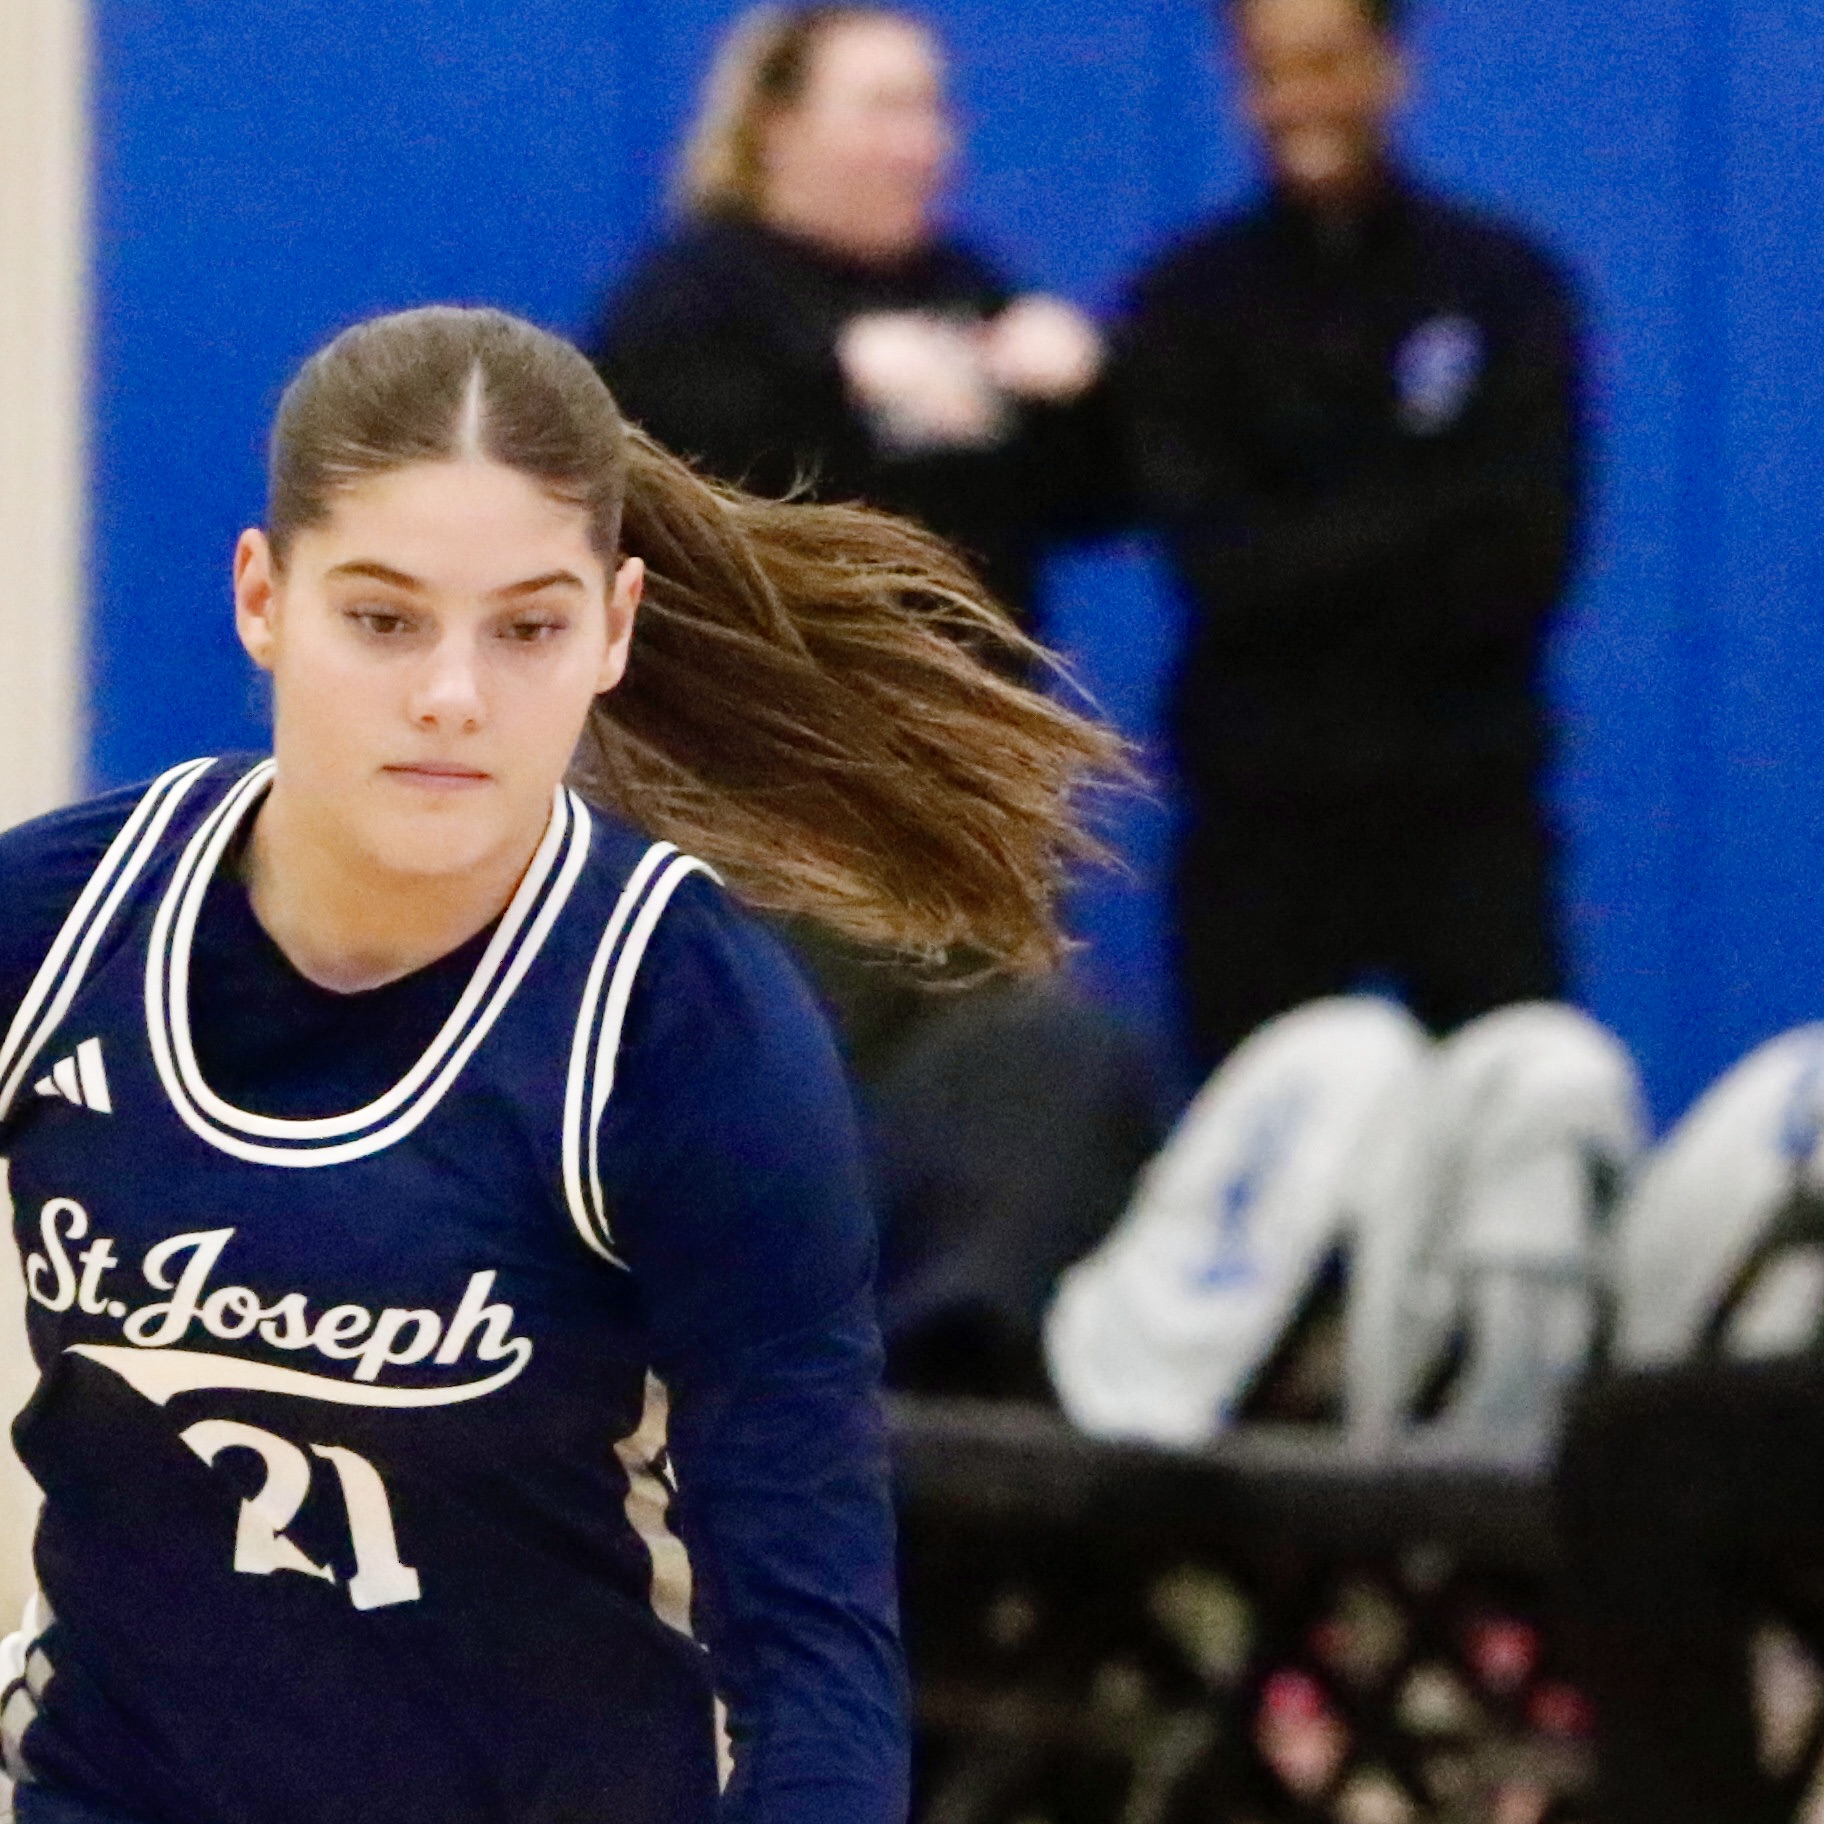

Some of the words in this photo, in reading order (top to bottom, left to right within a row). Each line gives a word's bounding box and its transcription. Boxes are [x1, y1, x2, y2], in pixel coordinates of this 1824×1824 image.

[25, 1197, 127, 1319] St.
[122, 1226, 534, 1382] Joseph
[178, 1418, 422, 1612] 21
